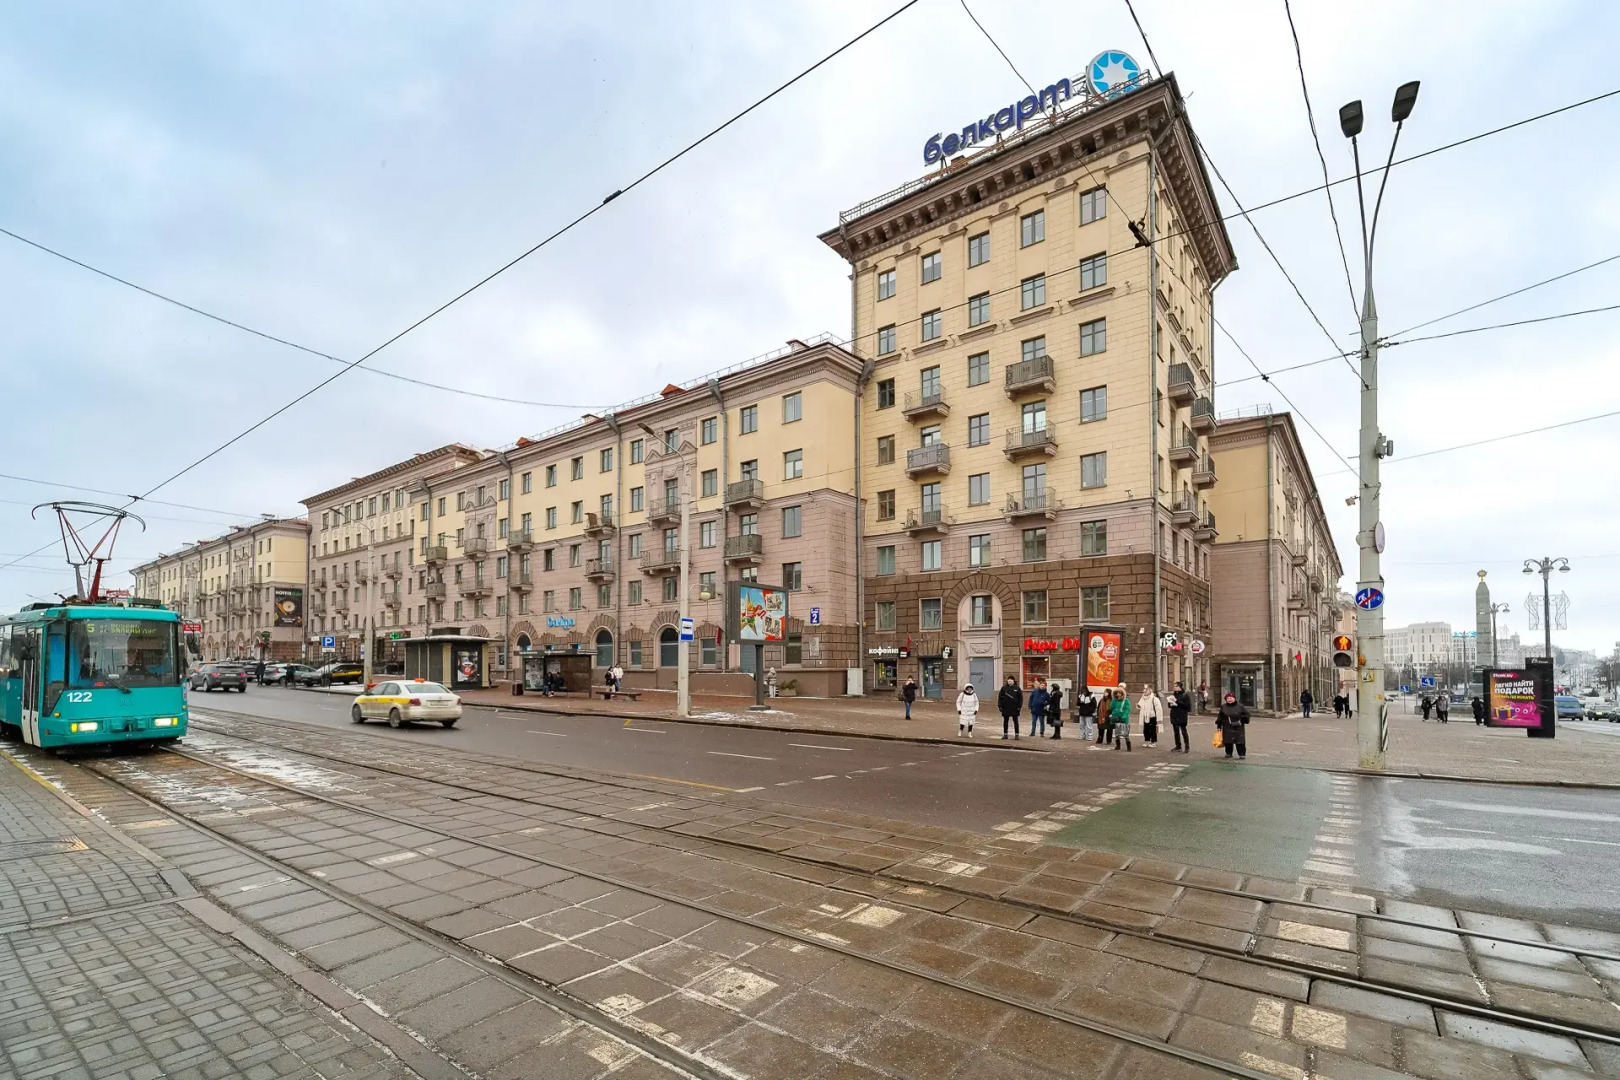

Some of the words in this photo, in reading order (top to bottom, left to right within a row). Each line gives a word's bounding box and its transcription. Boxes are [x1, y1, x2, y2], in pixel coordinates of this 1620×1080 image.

[924, 77, 1073, 166] белкарт
[812, 613, 818, 623] 2
[87, 623, 95, 633] 5
[325, 637, 332, 647] P
[1024, 638, 1058, 653] Papa
[1092, 641, 1098, 649] 6
[1494, 687, 1535, 695] ПОДАРОК
[66, 691, 93, 703] 122
